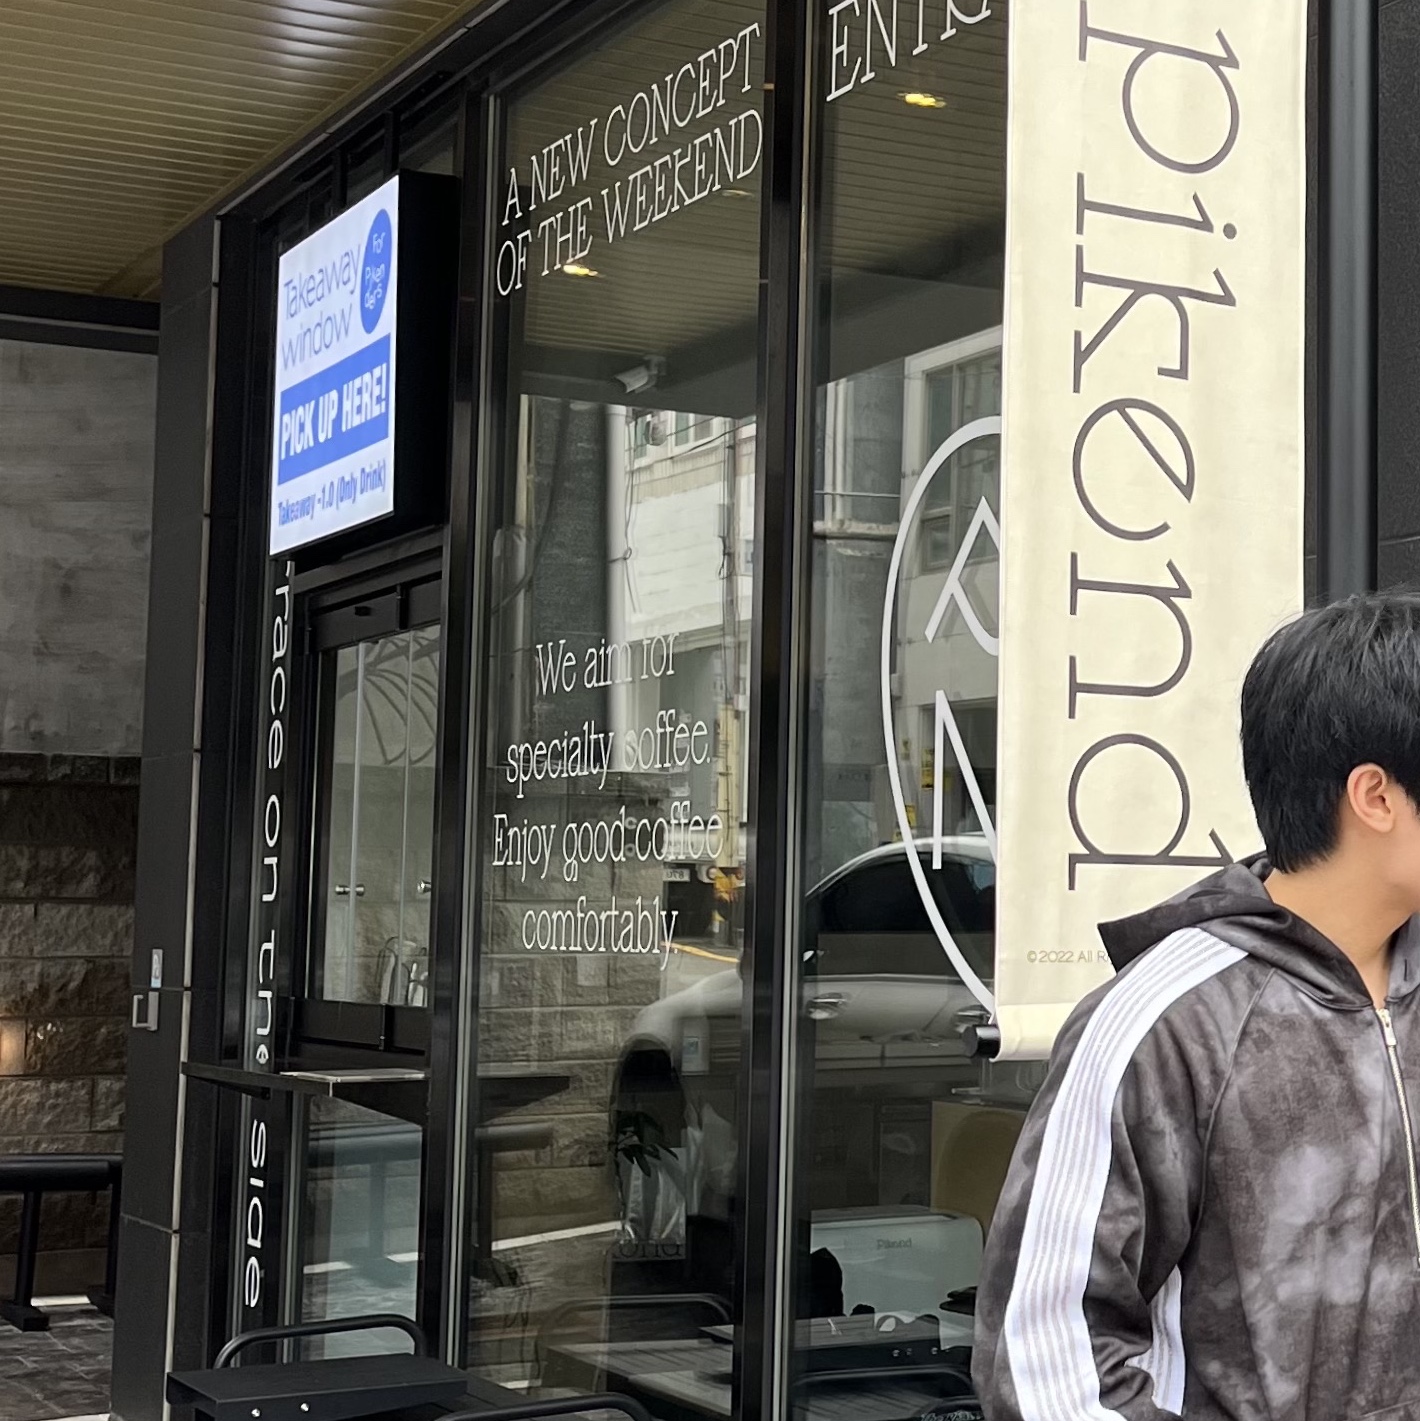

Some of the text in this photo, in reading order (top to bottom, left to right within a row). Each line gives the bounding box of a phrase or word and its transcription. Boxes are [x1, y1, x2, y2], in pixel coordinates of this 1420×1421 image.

[502, 23, 760, 226] A NEW CONCEPT
[497, 109, 763, 296] OF THE WEEKEND
[284, 243, 361, 319] Takeaway
[282, 303, 352, 371] window
[281, 363, 387, 460] PICK UP HERE!
[1068, 0, 1240, 891] pikend
[268, 560, 291, 770] race
[536, 633, 680, 695] We aim for
[506, 709, 711, 798] specialty coffee.
[261, 795, 280, 901] on
[492, 801, 723, 882] Enjoy good coffee
[522, 896, 679, 971] comfortably.
[1077, 950, 1093, 962] All
